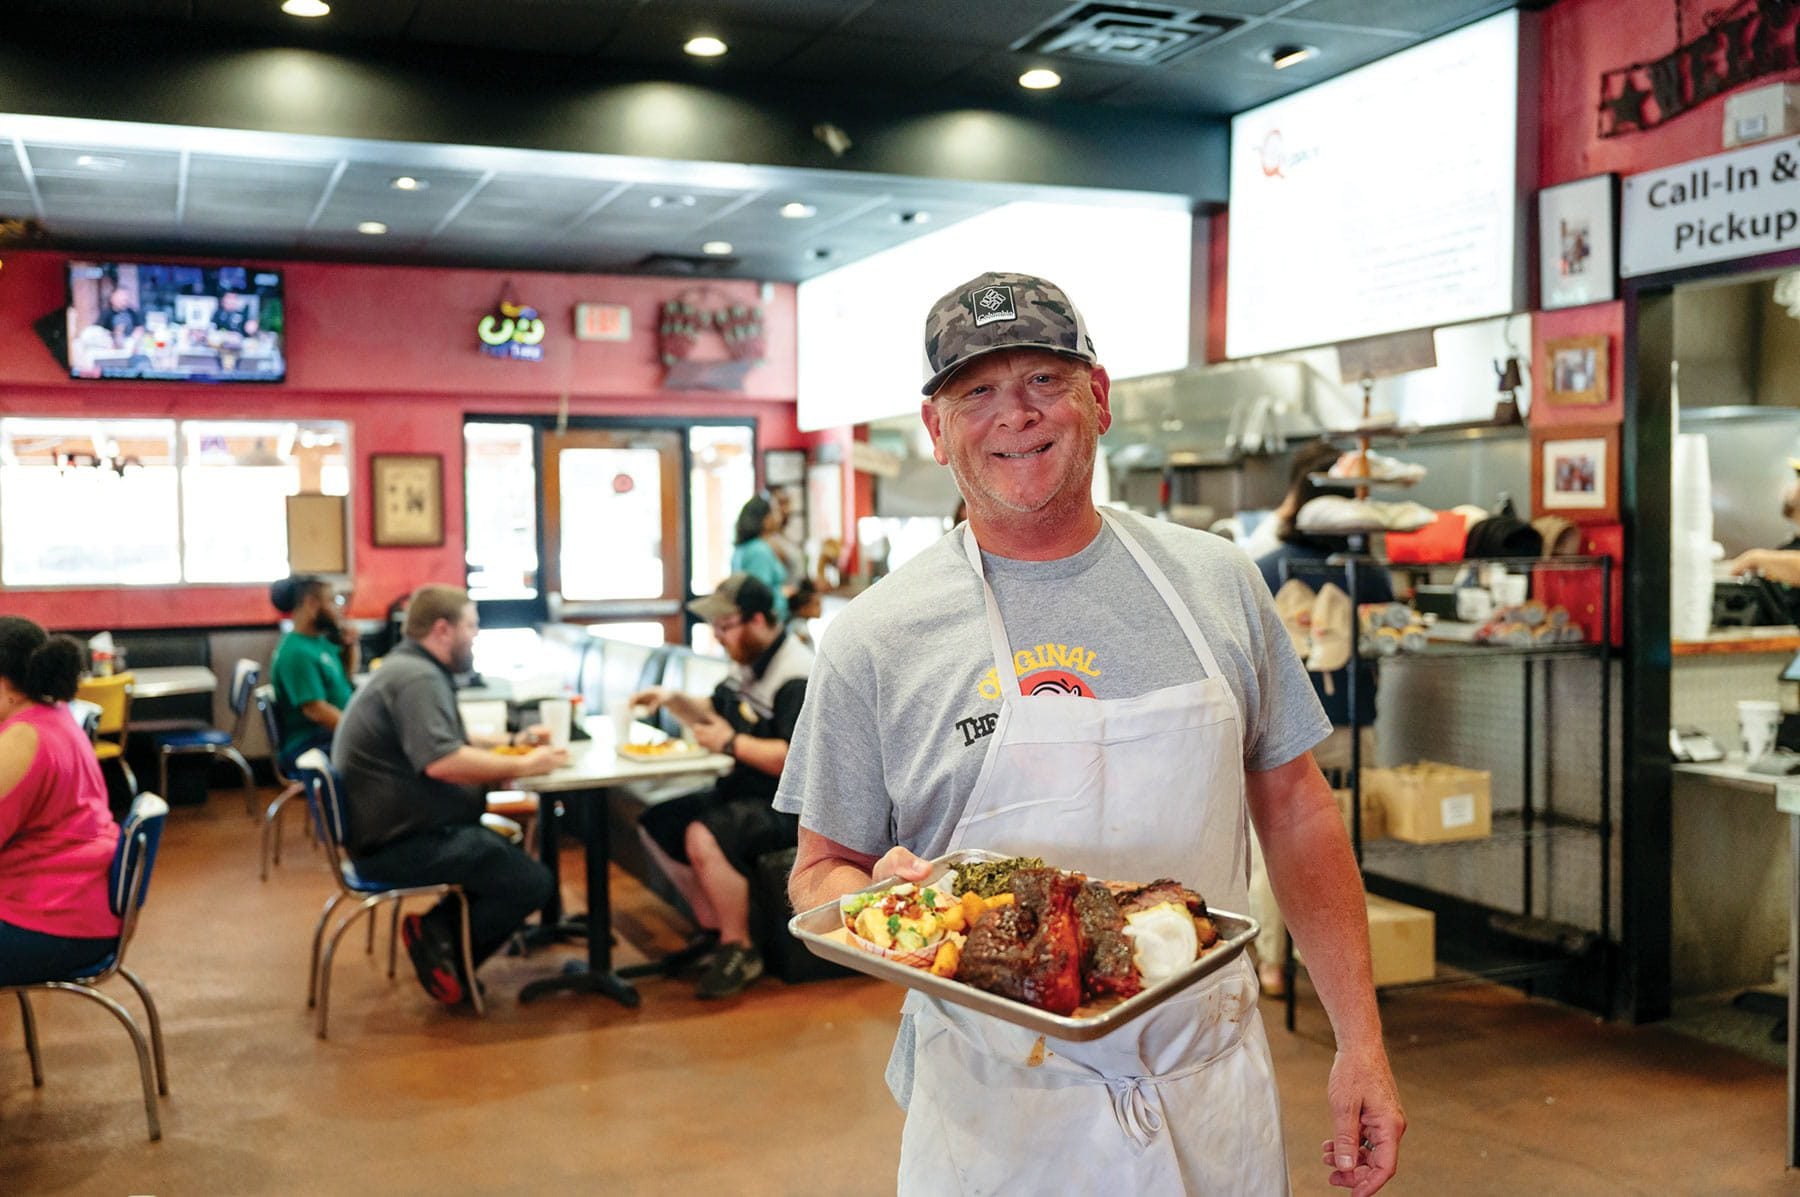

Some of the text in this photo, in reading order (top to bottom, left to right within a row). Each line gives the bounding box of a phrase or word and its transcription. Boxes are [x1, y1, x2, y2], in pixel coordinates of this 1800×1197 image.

[1648, 152, 1798, 208] Call-In &
[1675, 210, 1798, 251] Pickup
[977, 642, 1101, 701] OGINAL
